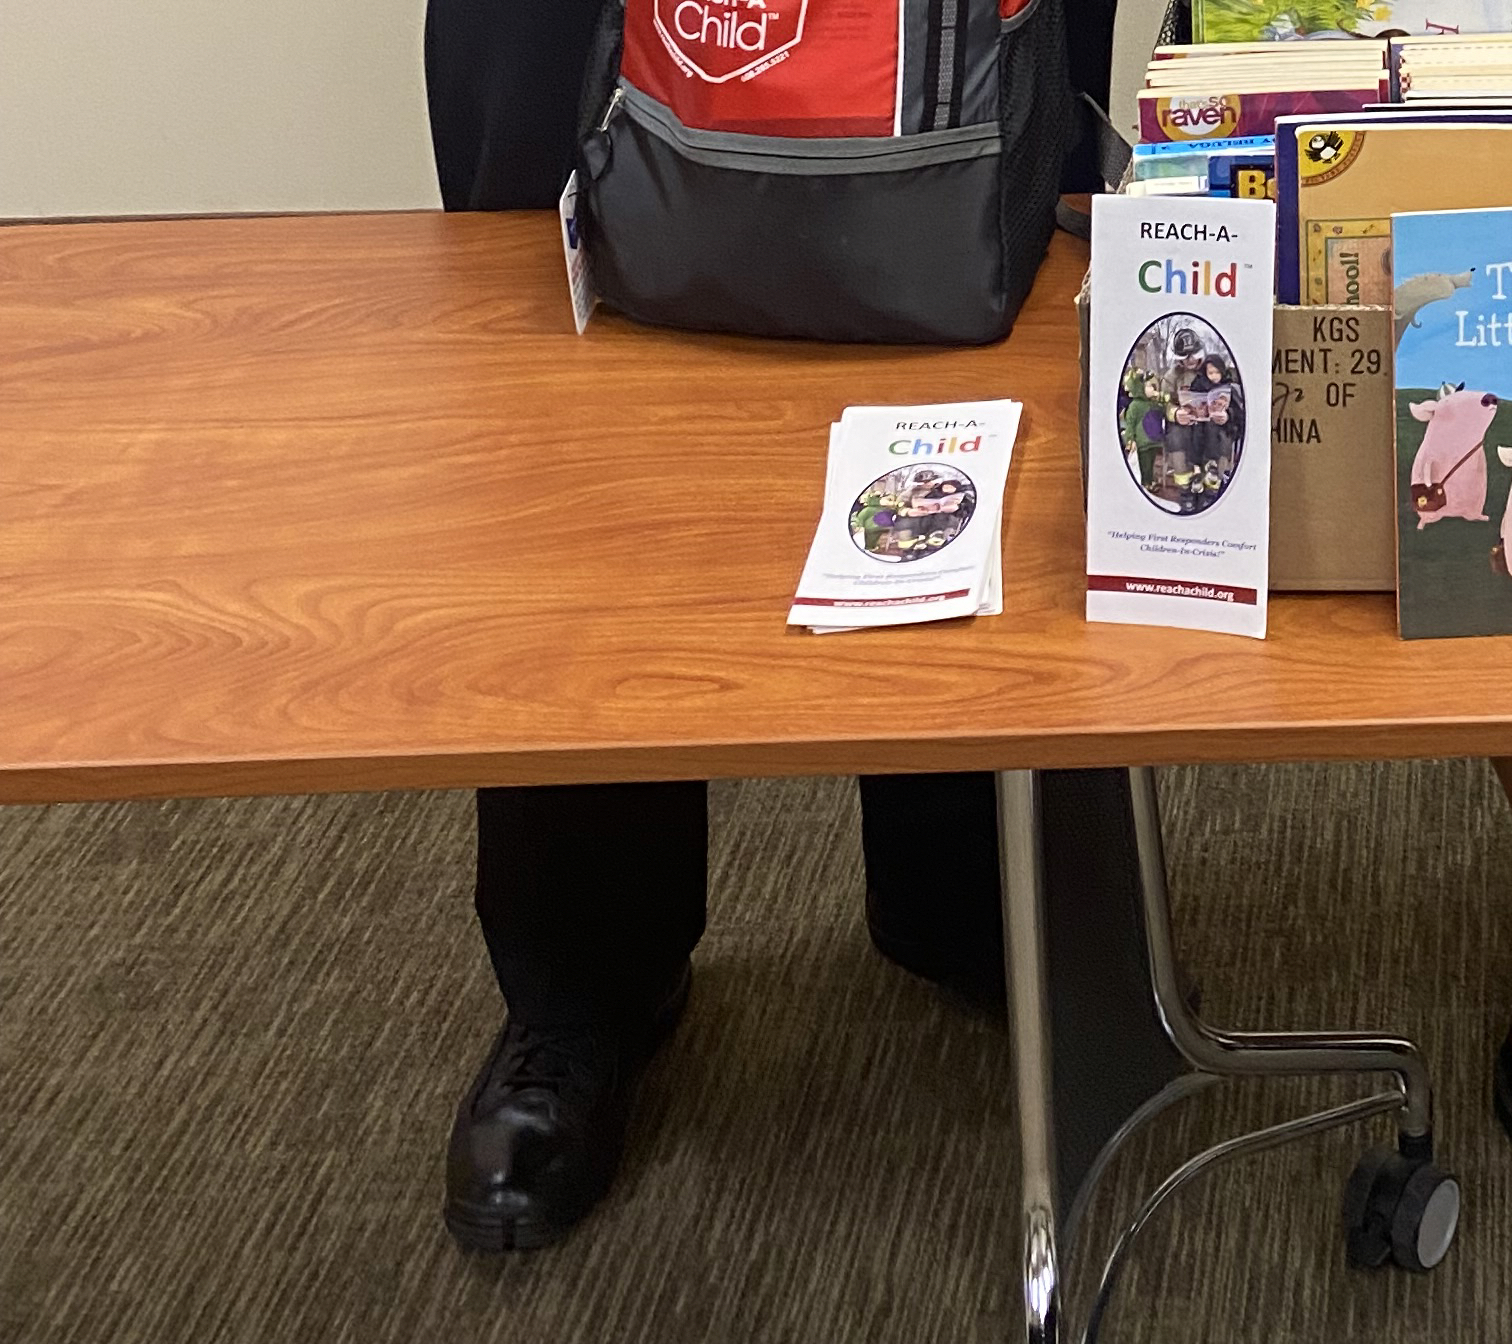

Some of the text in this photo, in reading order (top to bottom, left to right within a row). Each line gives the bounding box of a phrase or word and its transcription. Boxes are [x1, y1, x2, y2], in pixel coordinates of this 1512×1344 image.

[1161, 105, 1237, 128] raven
[1140, 222, 1238, 242] REACH-A-
[1313, 316, 1360, 342] KGS
[1326, 382, 1357, 407] OF
[896, 419, 985, 431] REACH-A-
[1126, 581, 1235, 602] www.reachachild.org
